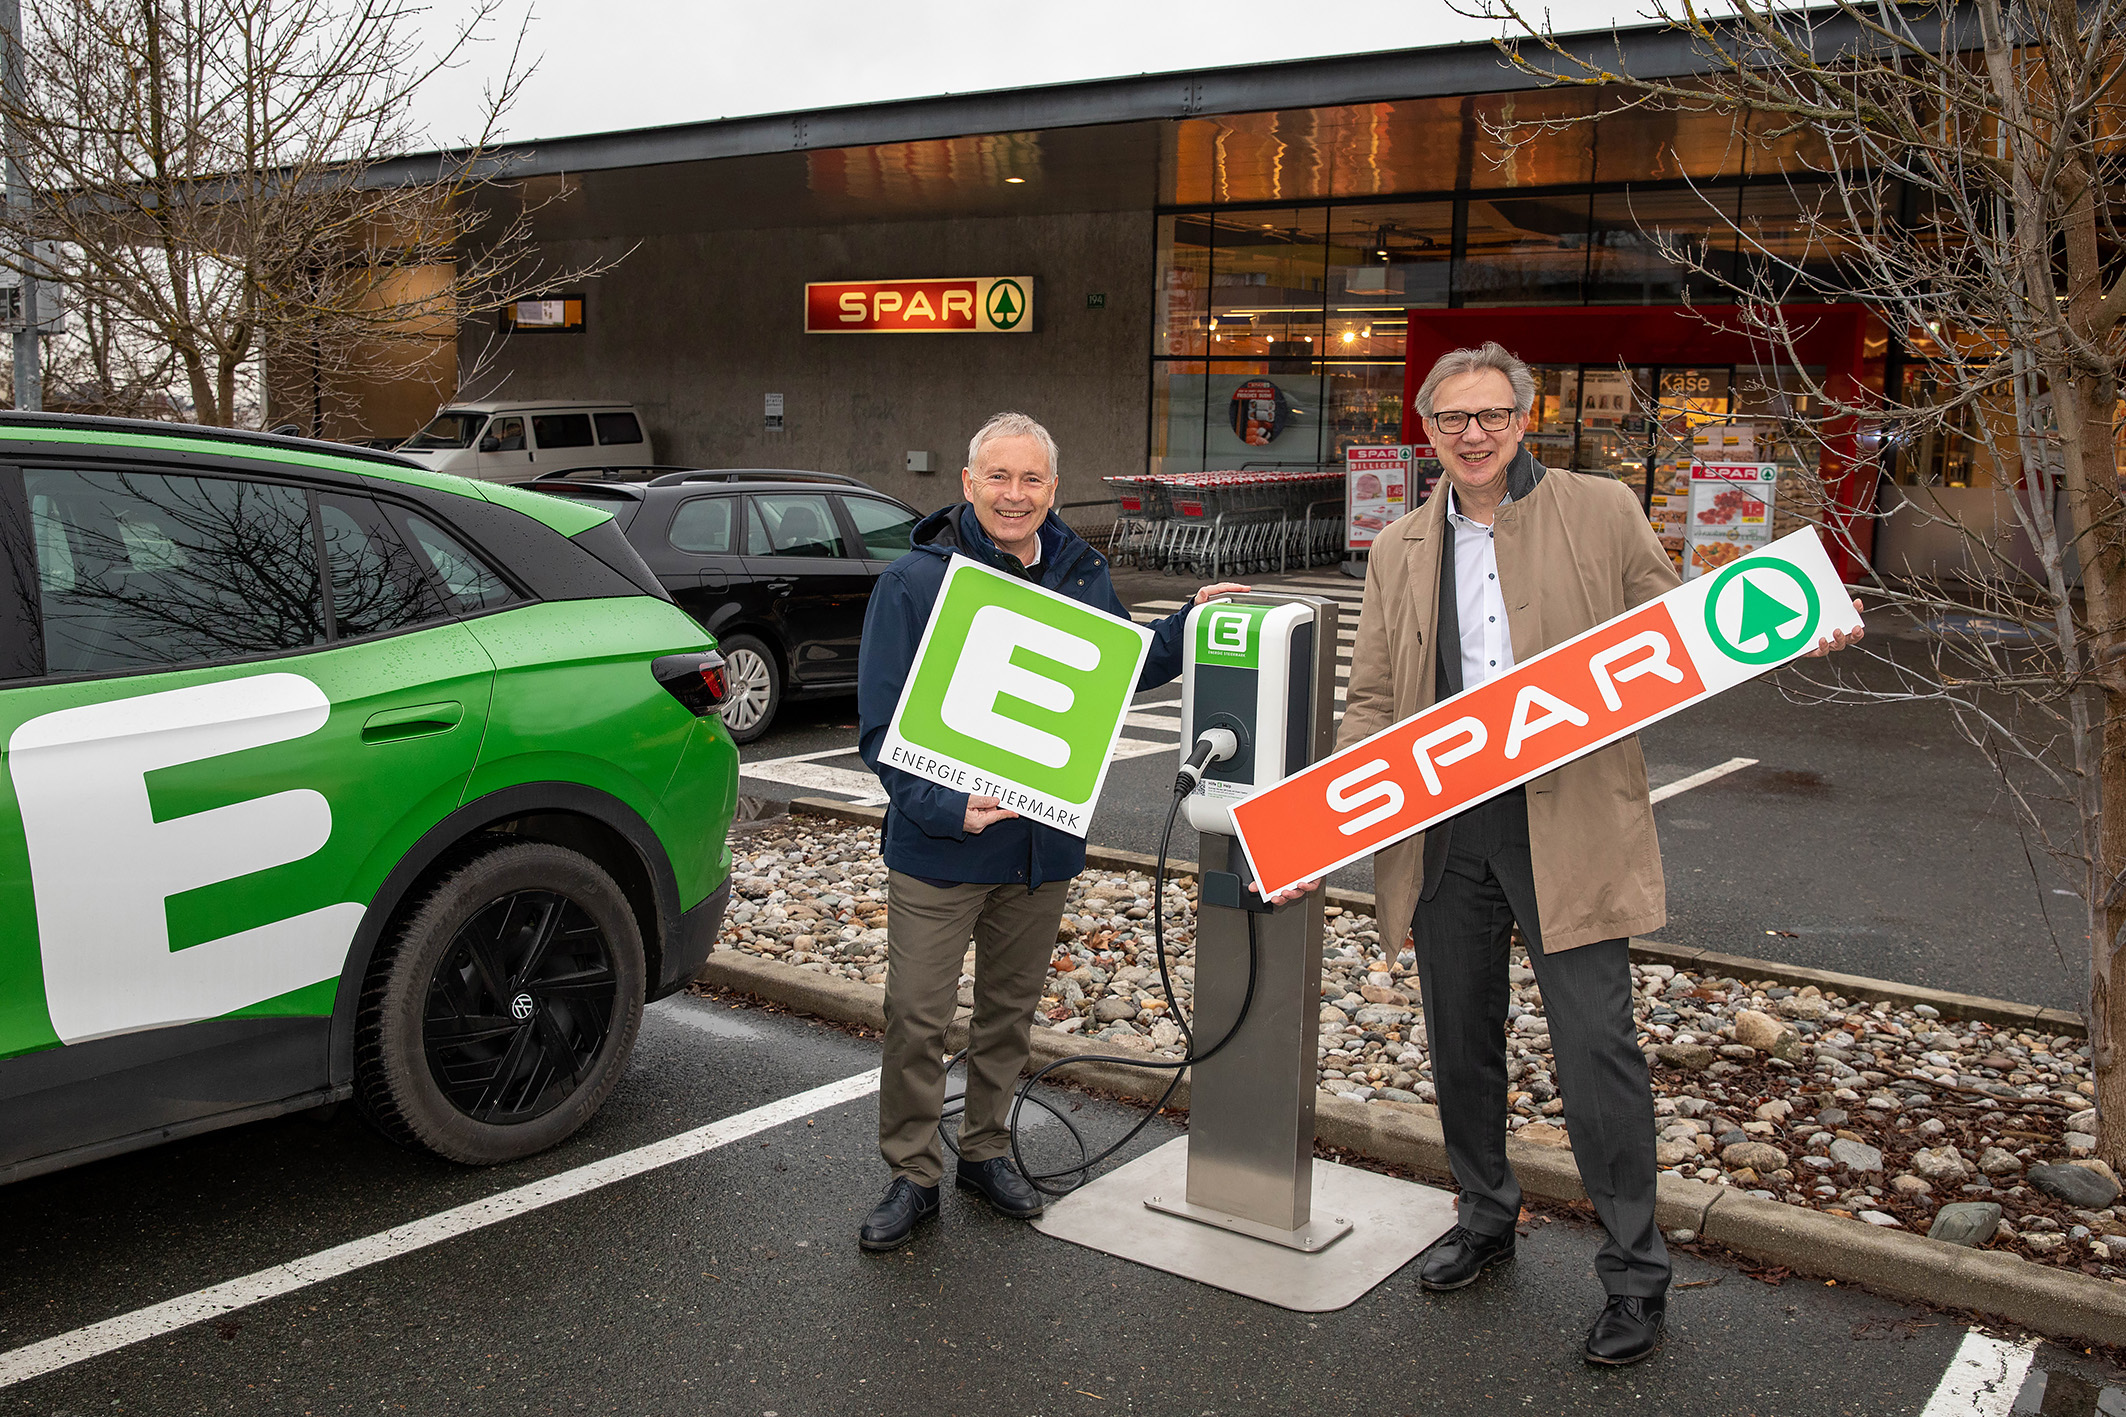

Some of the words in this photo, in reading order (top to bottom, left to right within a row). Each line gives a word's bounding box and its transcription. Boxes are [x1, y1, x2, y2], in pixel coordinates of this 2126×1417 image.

[839, 290, 973, 321] SPAR
[1660, 373, 1710, 392] Käse
[1351, 462, 1406, 470] BILLIGER!
[1358, 450, 1397, 458] SPAR
[1704, 468, 1757, 478] SPAR
[1215, 616, 1242, 646] E
[941, 605, 1101, 768] E
[1326, 631, 1684, 836] SPAR
[891, 747, 967, 786] ENERGIE
[972, 777, 1080, 829] STEIERMARK
[9, 672, 367, 1046] E
